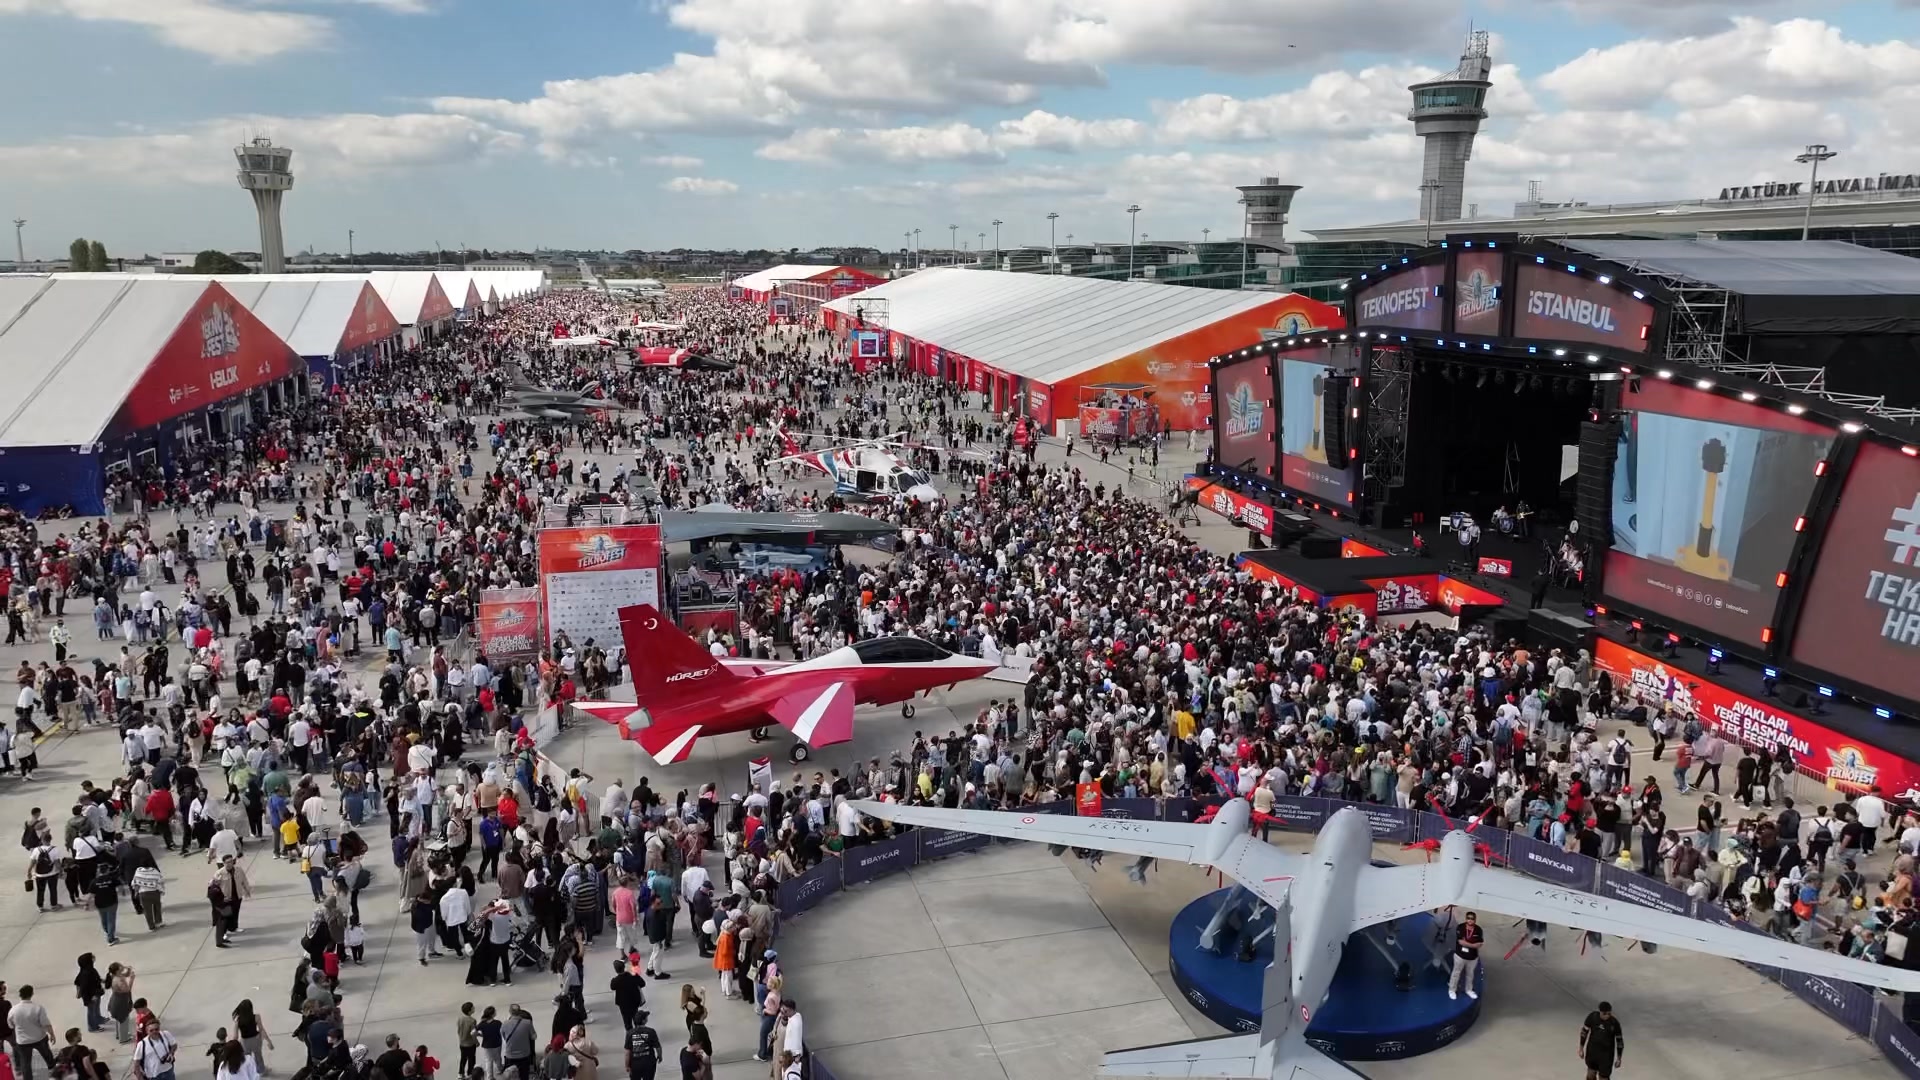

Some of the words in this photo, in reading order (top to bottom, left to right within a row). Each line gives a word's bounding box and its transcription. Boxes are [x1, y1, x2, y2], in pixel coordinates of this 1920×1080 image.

[1719, 181, 1803, 201] ATATÜRK
[1814, 173, 1920, 194] HAVALİMA
[1362, 287, 1429, 319] TEKNOFEST
[1528, 291, 1614, 331] İSTANBUL
[578, 547, 626, 568] TEKNOFEST
[1865, 570, 1920, 611] TEK
[1377, 599, 1399, 611] EST
[666, 668, 710, 683] HÜRJET
[1631, 667, 1669, 690] TEKNO
[1631, 682, 1667, 702] FEST
[1732, 700, 1789, 732] AYAKLARI
[1713, 703, 1741, 725] YERE
[1743, 718, 1809, 754] BASMAYAN
[1720, 719, 1742, 737] TEK
[1826, 767, 1878, 785] TEKNOFEST
[866, 849, 900, 865] BAYKAR
[1534, 855, 1575, 874] BAYKAR
